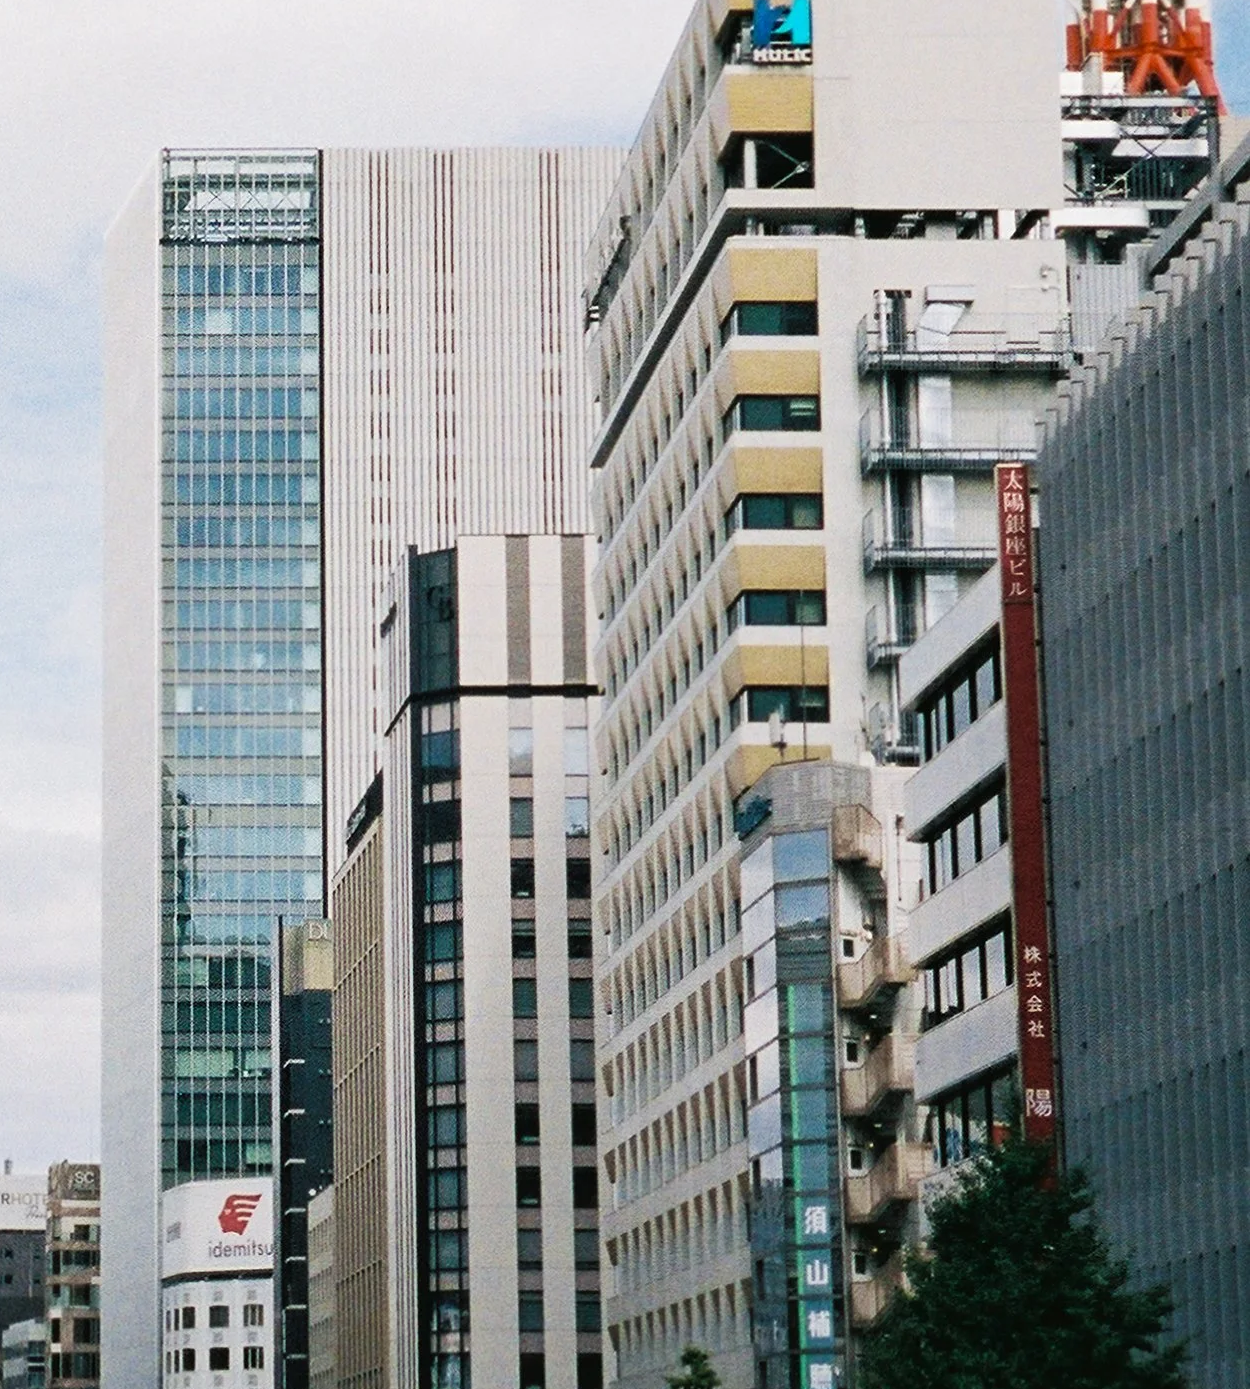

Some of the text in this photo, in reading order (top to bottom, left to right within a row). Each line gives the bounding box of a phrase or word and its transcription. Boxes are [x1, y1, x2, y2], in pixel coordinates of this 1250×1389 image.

[1002, 469, 1028, 597] 太陽銀座ビル
[1023, 945, 1046, 1038] 株式会社
[208, 1240, 278, 1258] idemitsu
